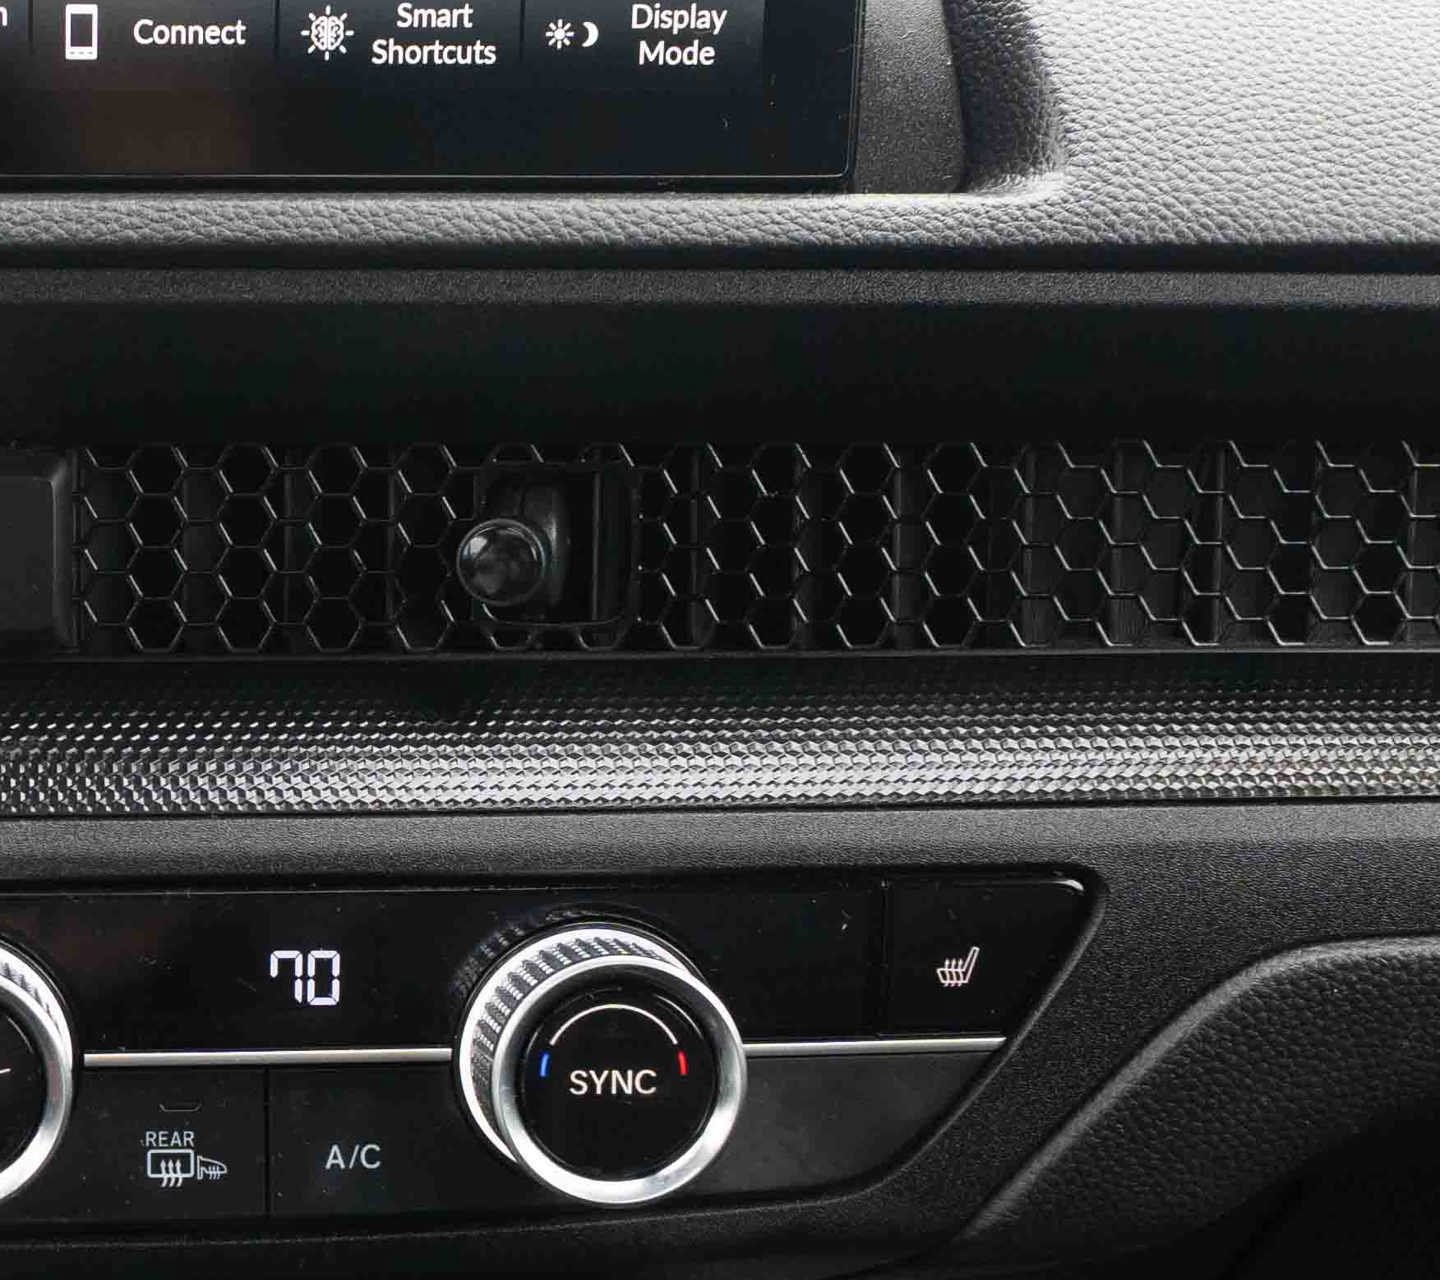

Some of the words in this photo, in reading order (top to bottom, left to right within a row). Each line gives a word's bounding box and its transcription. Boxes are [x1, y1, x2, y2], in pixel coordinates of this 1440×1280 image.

[396, 2, 474, 29] Smart
[631, 2, 728, 35] Display
[133, 18, 247, 45] Connect
[371, 37, 497, 65] Shortcuts
[638, 39, 716, 66] Mode
[269, 949, 341, 1006] 70
[569, 1069, 657, 1095] SYNC
[145, 1130, 195, 1151] REAR
[325, 1143, 381, 1170] A/C
